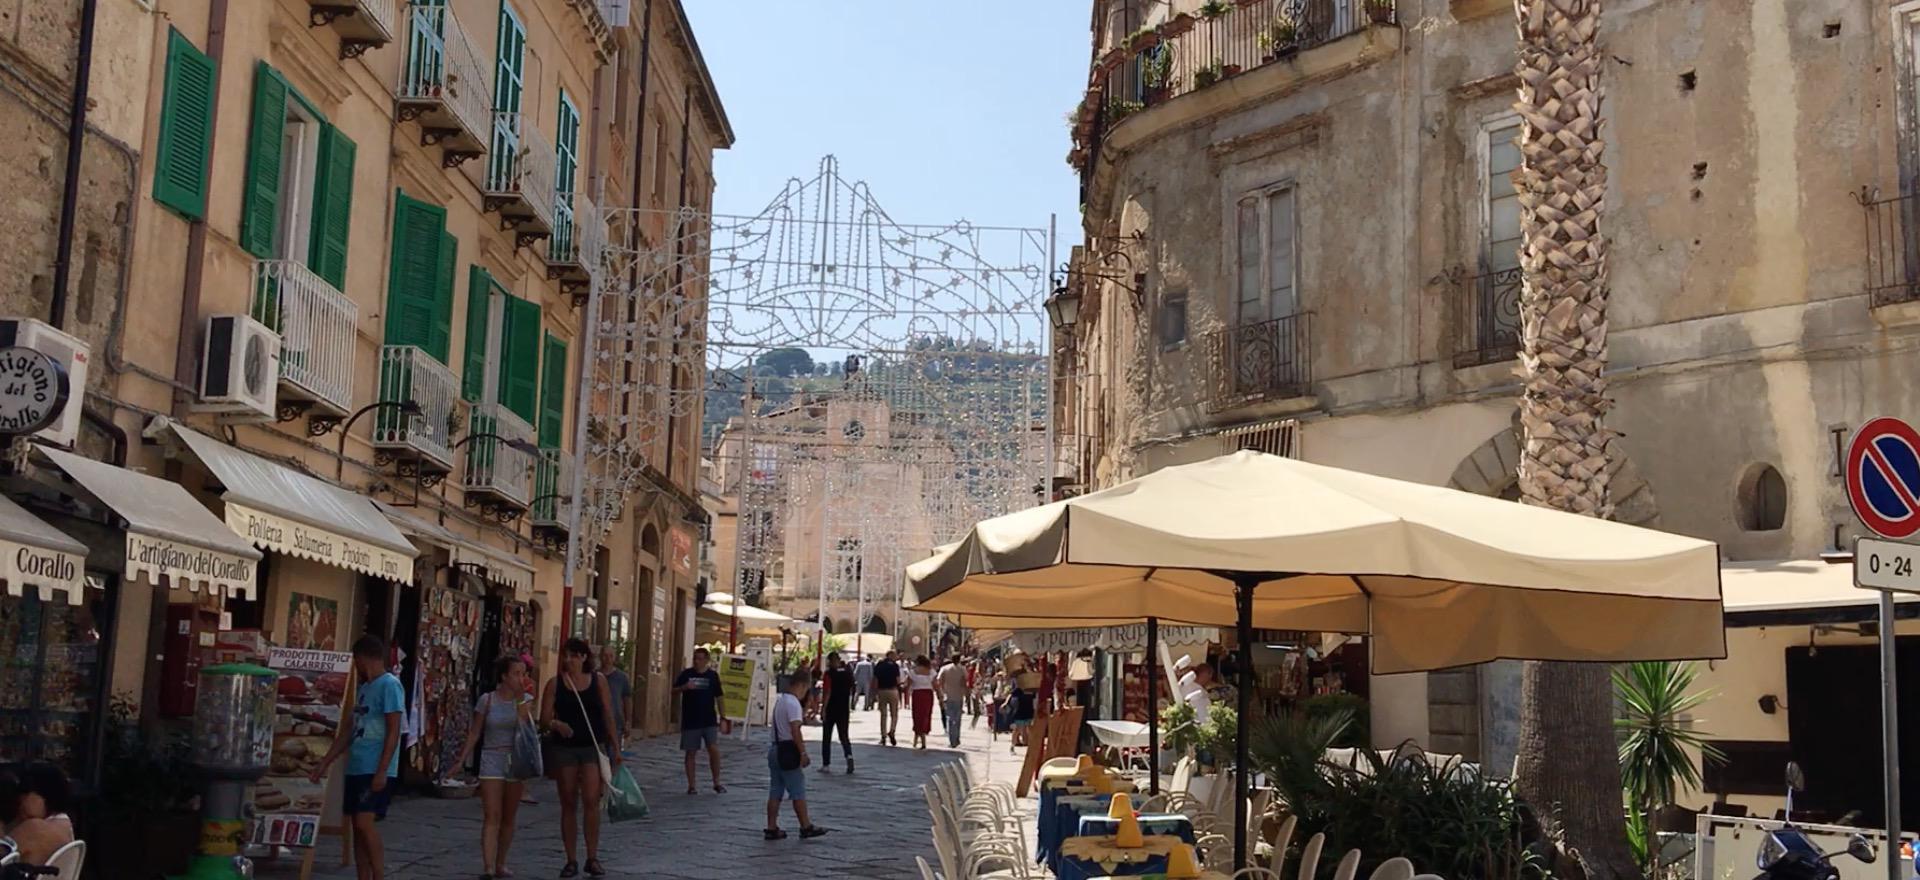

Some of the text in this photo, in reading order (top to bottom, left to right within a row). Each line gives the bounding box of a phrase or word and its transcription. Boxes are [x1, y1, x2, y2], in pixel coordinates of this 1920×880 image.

[5, 382, 26, 396] del
[247, 515, 283, 543] Polleria
[294, 527, 332, 557] Salumeria
[16, 547, 75, 581] Corallo
[212, 556, 250, 582] Corallo
[1894, 556, 1912, 577] 24
[272, 649, 350, 663] PRODOTTI TIPICI
[283, 660, 335, 672] CALABRESI
